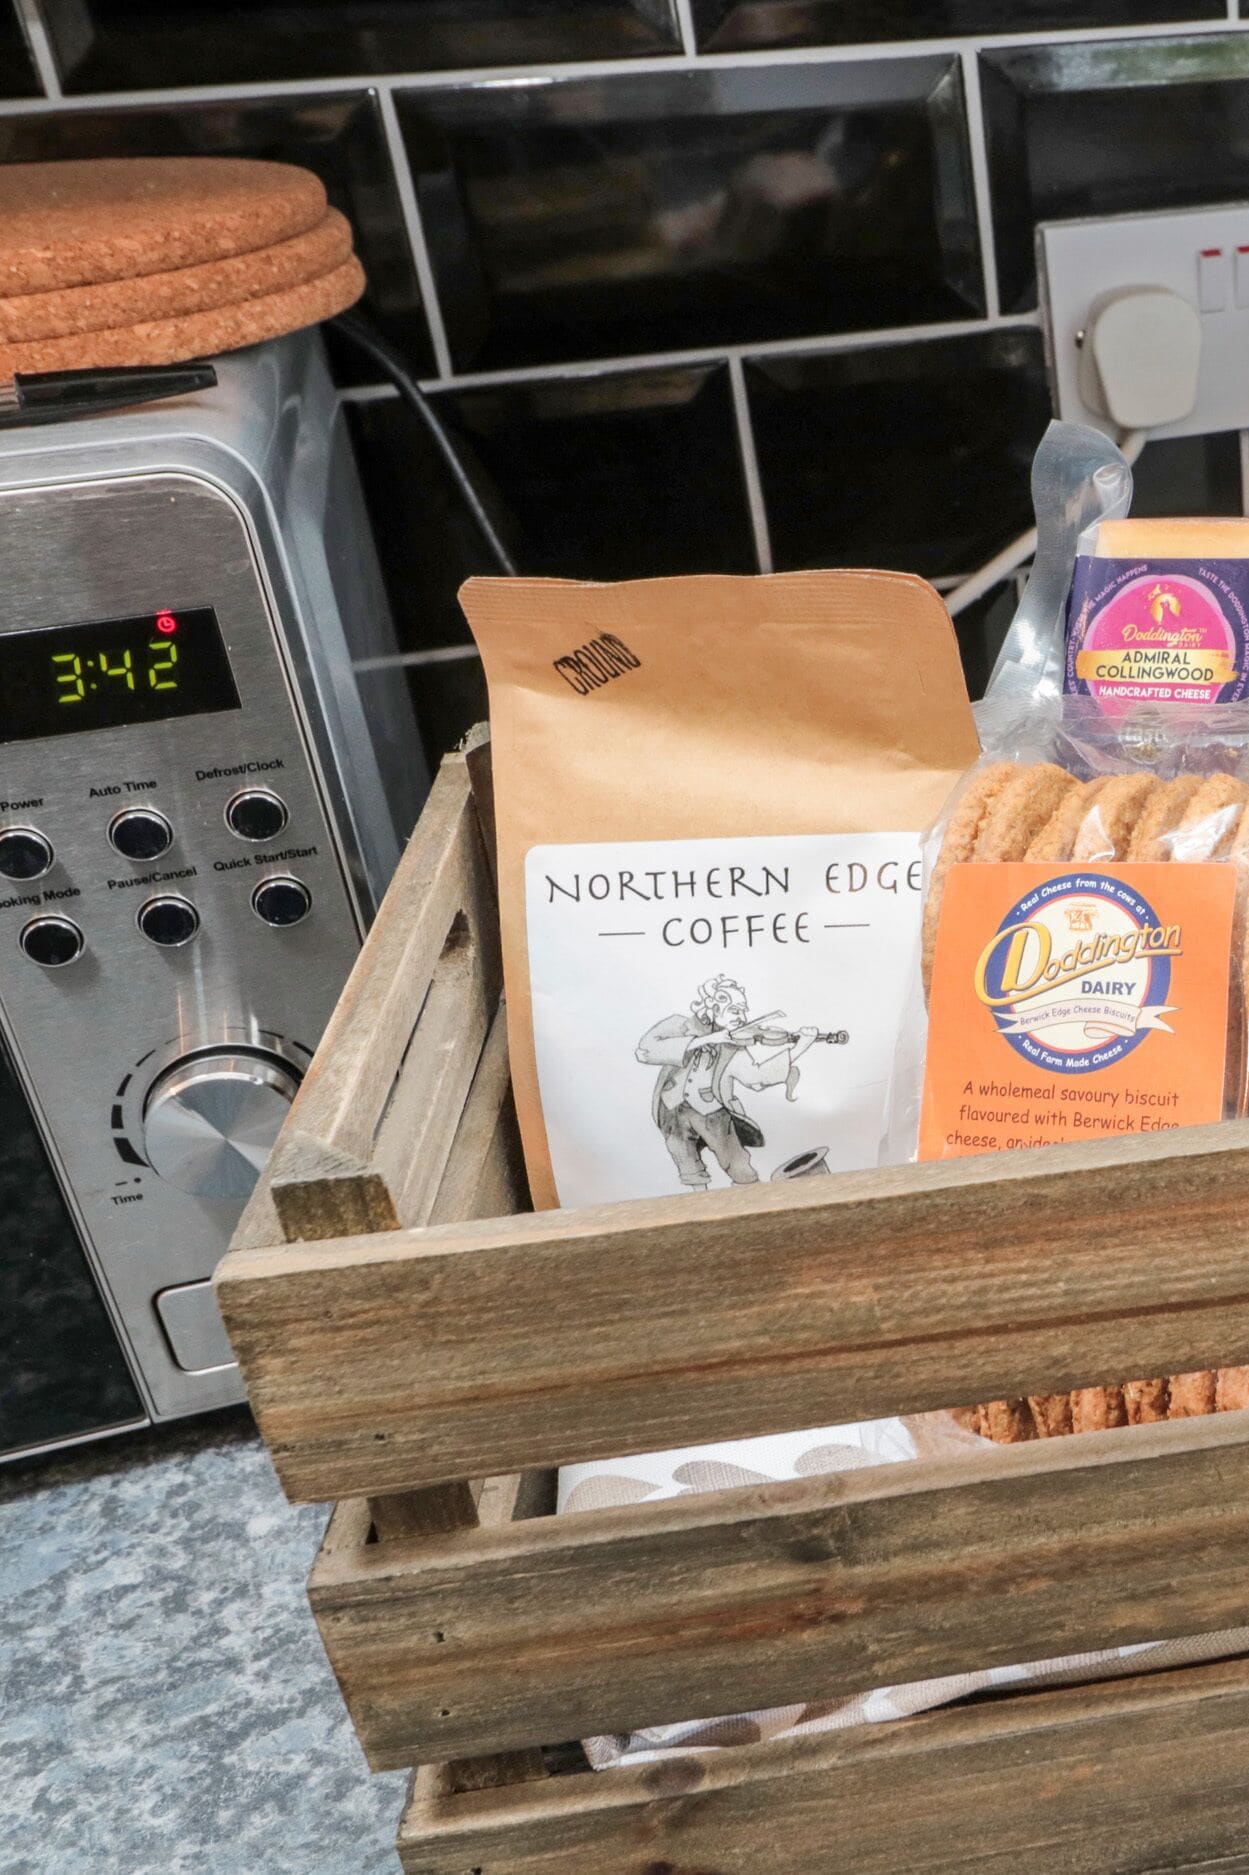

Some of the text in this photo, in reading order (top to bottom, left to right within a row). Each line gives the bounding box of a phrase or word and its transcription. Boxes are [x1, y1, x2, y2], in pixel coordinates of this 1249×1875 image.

[1095, 580, 1117, 602] MAGIC
[1117, 564, 1148, 584] HAPPENS
[1121, 624, 1202, 648] Doddington
[1198, 567, 1218, 584] TASTE
[1218, 580, 1231, 593] THE
[1240, 672, 1248, 682] IN
[1122, 651, 1191, 665] ADMIRAL
[52, 641, 178, 703] 3:42
[1096, 665, 1214, 682] COLLINGWOOD
[1099, 686, 1211, 699] HANDCRAFTED CHEESE
[195, 758, 285, 781] Defrost/Clock
[89, 779, 157, 799] Auto Time
[0, 798, 44, 812] Power
[213, 845, 318, 873] Quick Start/Start
[107, 867, 198, 890] Pause/Cancel
[545, 860, 923, 904] NORTHERN EDGE
[42, 886, 81, 900] Mode
[1020, 878, 1146, 915] Real Cheese from the cows at
[661, 912, 811, 949] COFFEE
[974, 921, 1184, 1007] Doddington
[1081, 980, 1137, 996] DAIRY
[1020, 1006, 1135, 1026] Berwick Edge Cheese Biscuits
[1022, 1039, 1122, 1067] Real Farm Made Cheese
[963, 1081, 1180, 1107] A wholemeal savoury biscuit
[959, 1105, 1029, 1124] flavoured
[1034, 1110, 1067, 1126] with
[1073, 1112, 1134, 1131] Berwick
[946, 1130, 1001, 1150] cheese,
[110, 1193, 143, 1205] Time
